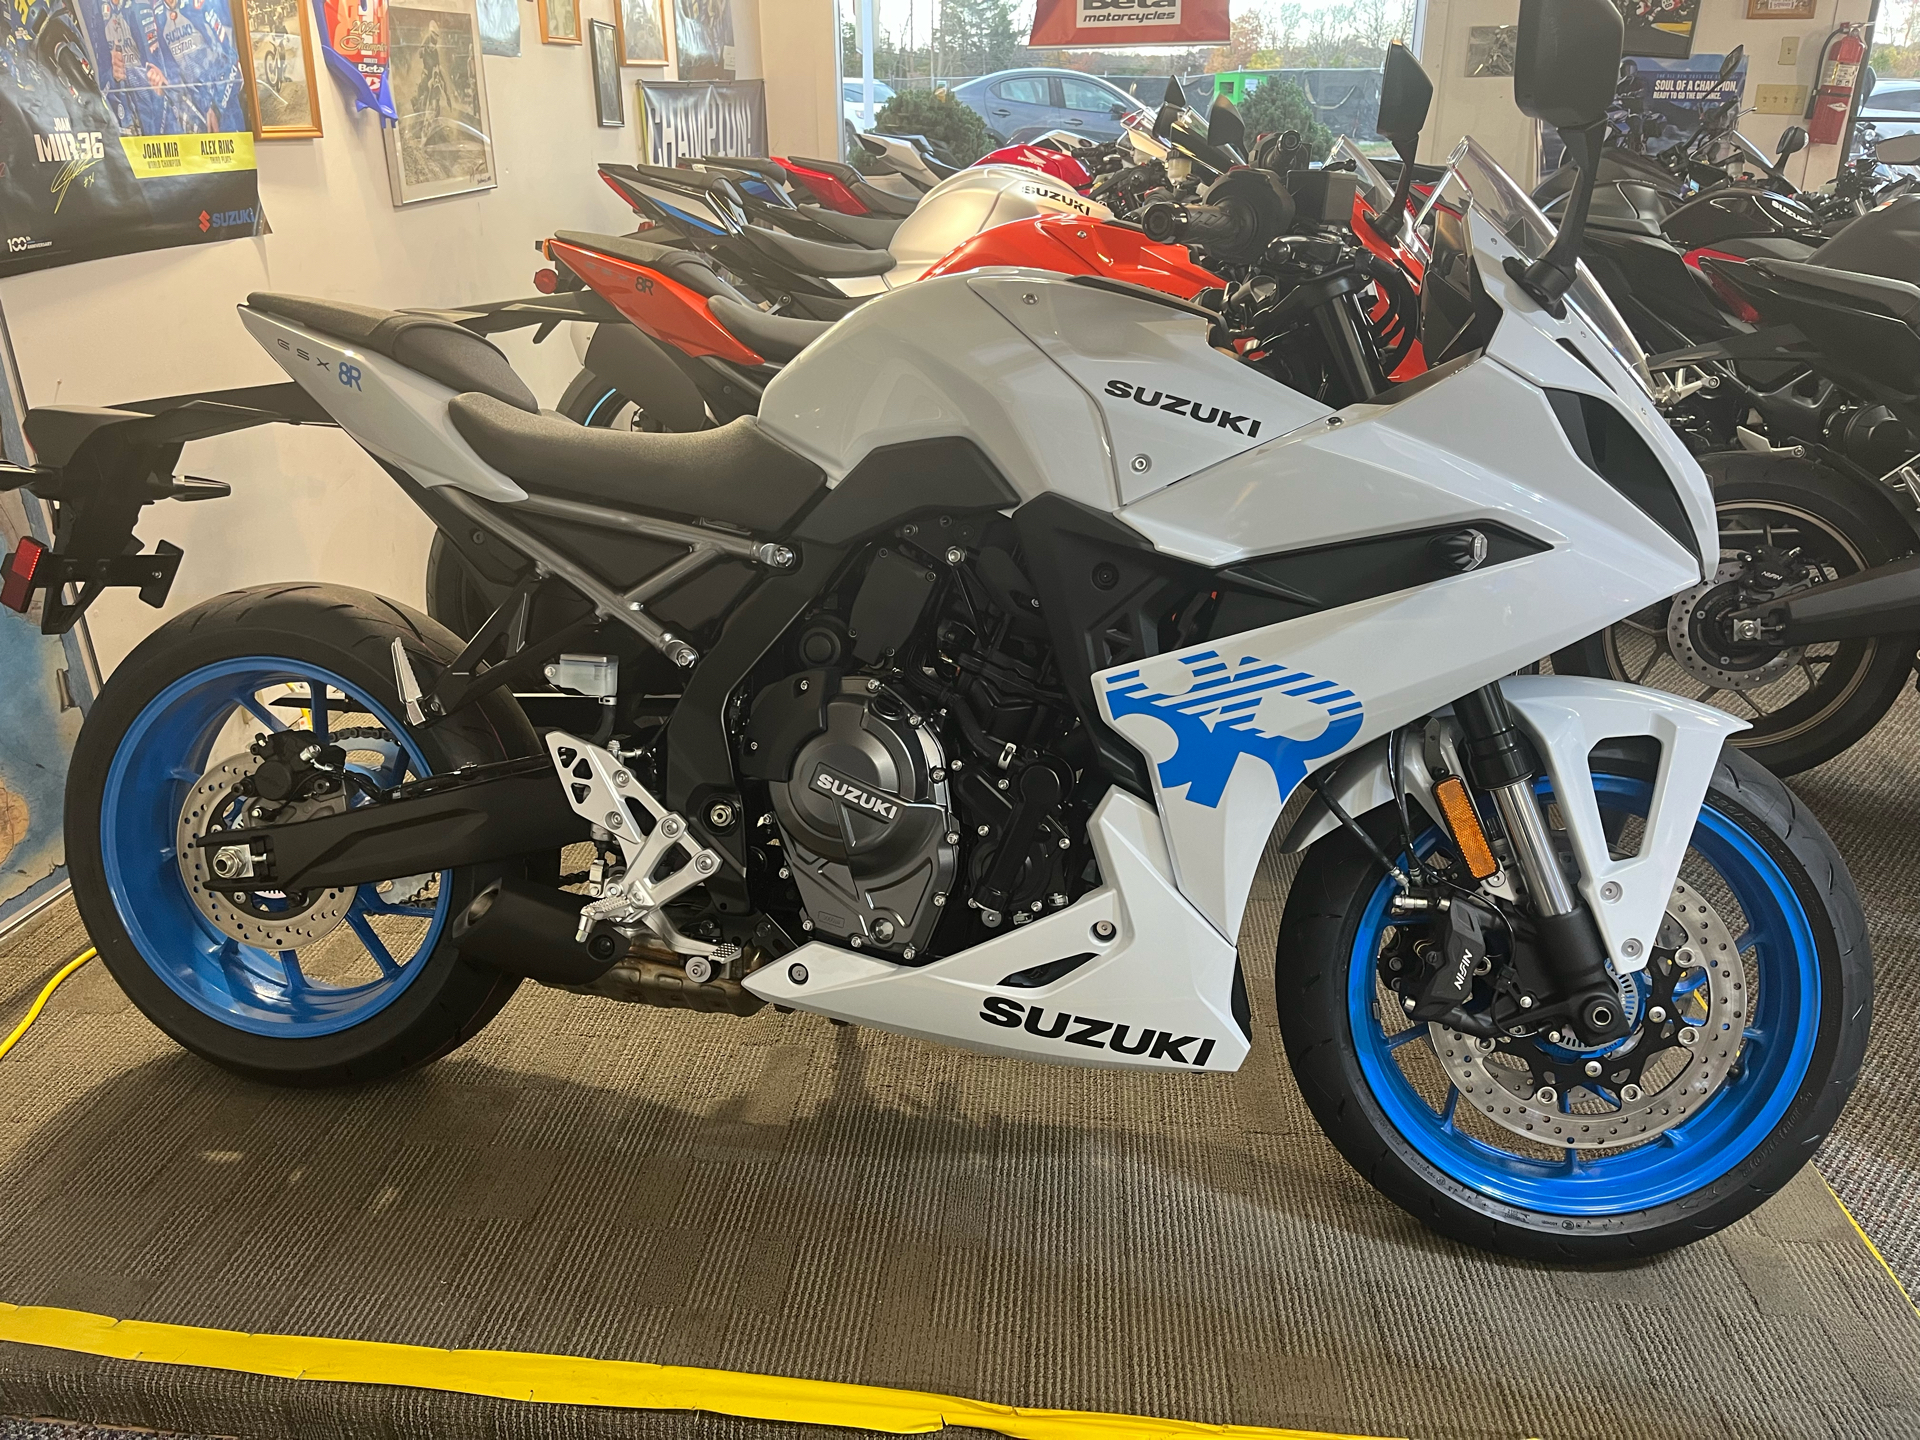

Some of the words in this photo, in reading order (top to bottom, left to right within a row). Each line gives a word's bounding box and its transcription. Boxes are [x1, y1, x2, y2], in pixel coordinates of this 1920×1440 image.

[1083, 11, 1176, 23] motorcycles
[350, 20, 381, 36] 2024
[358, 64, 384, 73] Beta
[1655, 80, 1674, 91] SOUL
[1676, 80, 1687, 91] OF
[1687, 80, 1693, 91] A
[53, 117, 72, 132] JOAN
[142, 143, 162, 159] JOAN
[163, 141, 180, 158] MIR
[200, 140, 217, 156] ALEX
[218, 139, 235, 154] RINS
[1022, 185, 1090, 216] SUZUKI
[212, 207, 255, 228] SUZUKI
[635, 276, 654, 296] 8R
[1104, 380, 1261, 438] SUZUKI
[817, 773, 898, 820] SUZUKI
[1454, 948, 1473, 991] NISSIN
[979, 996, 1216, 1067] SUZUKI
